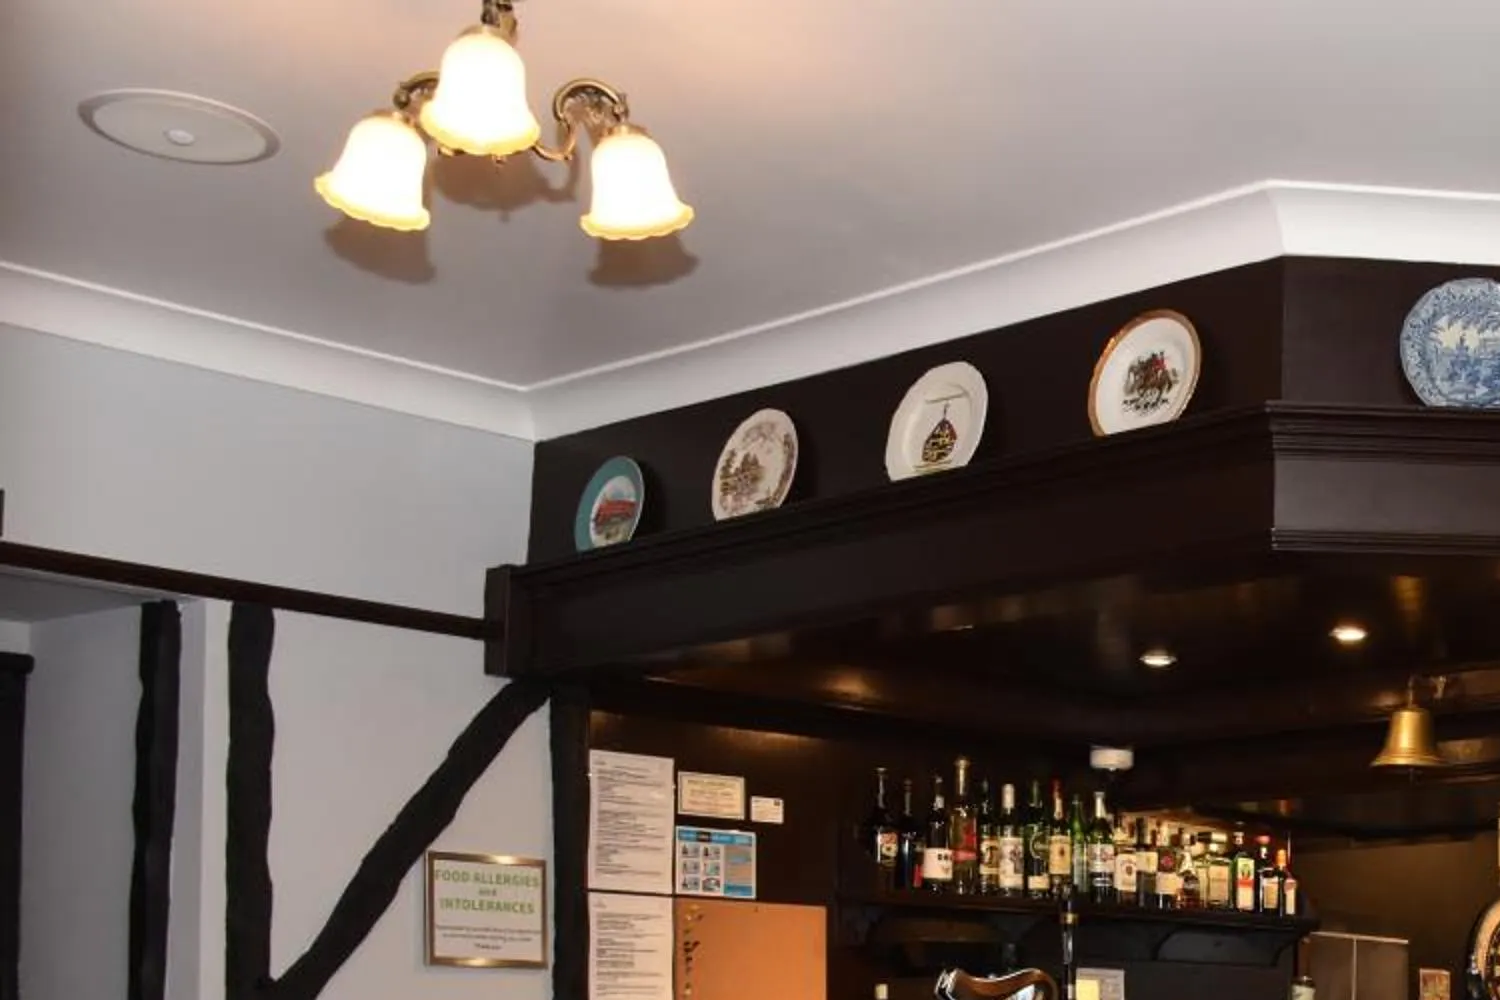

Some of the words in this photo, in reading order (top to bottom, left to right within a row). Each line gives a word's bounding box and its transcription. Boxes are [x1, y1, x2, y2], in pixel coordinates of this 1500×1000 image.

[434, 869, 470, 882] FOOD
[473, 870, 539, 887] ALLERGIES
[440, 897, 535, 914] INTOLERANCES
